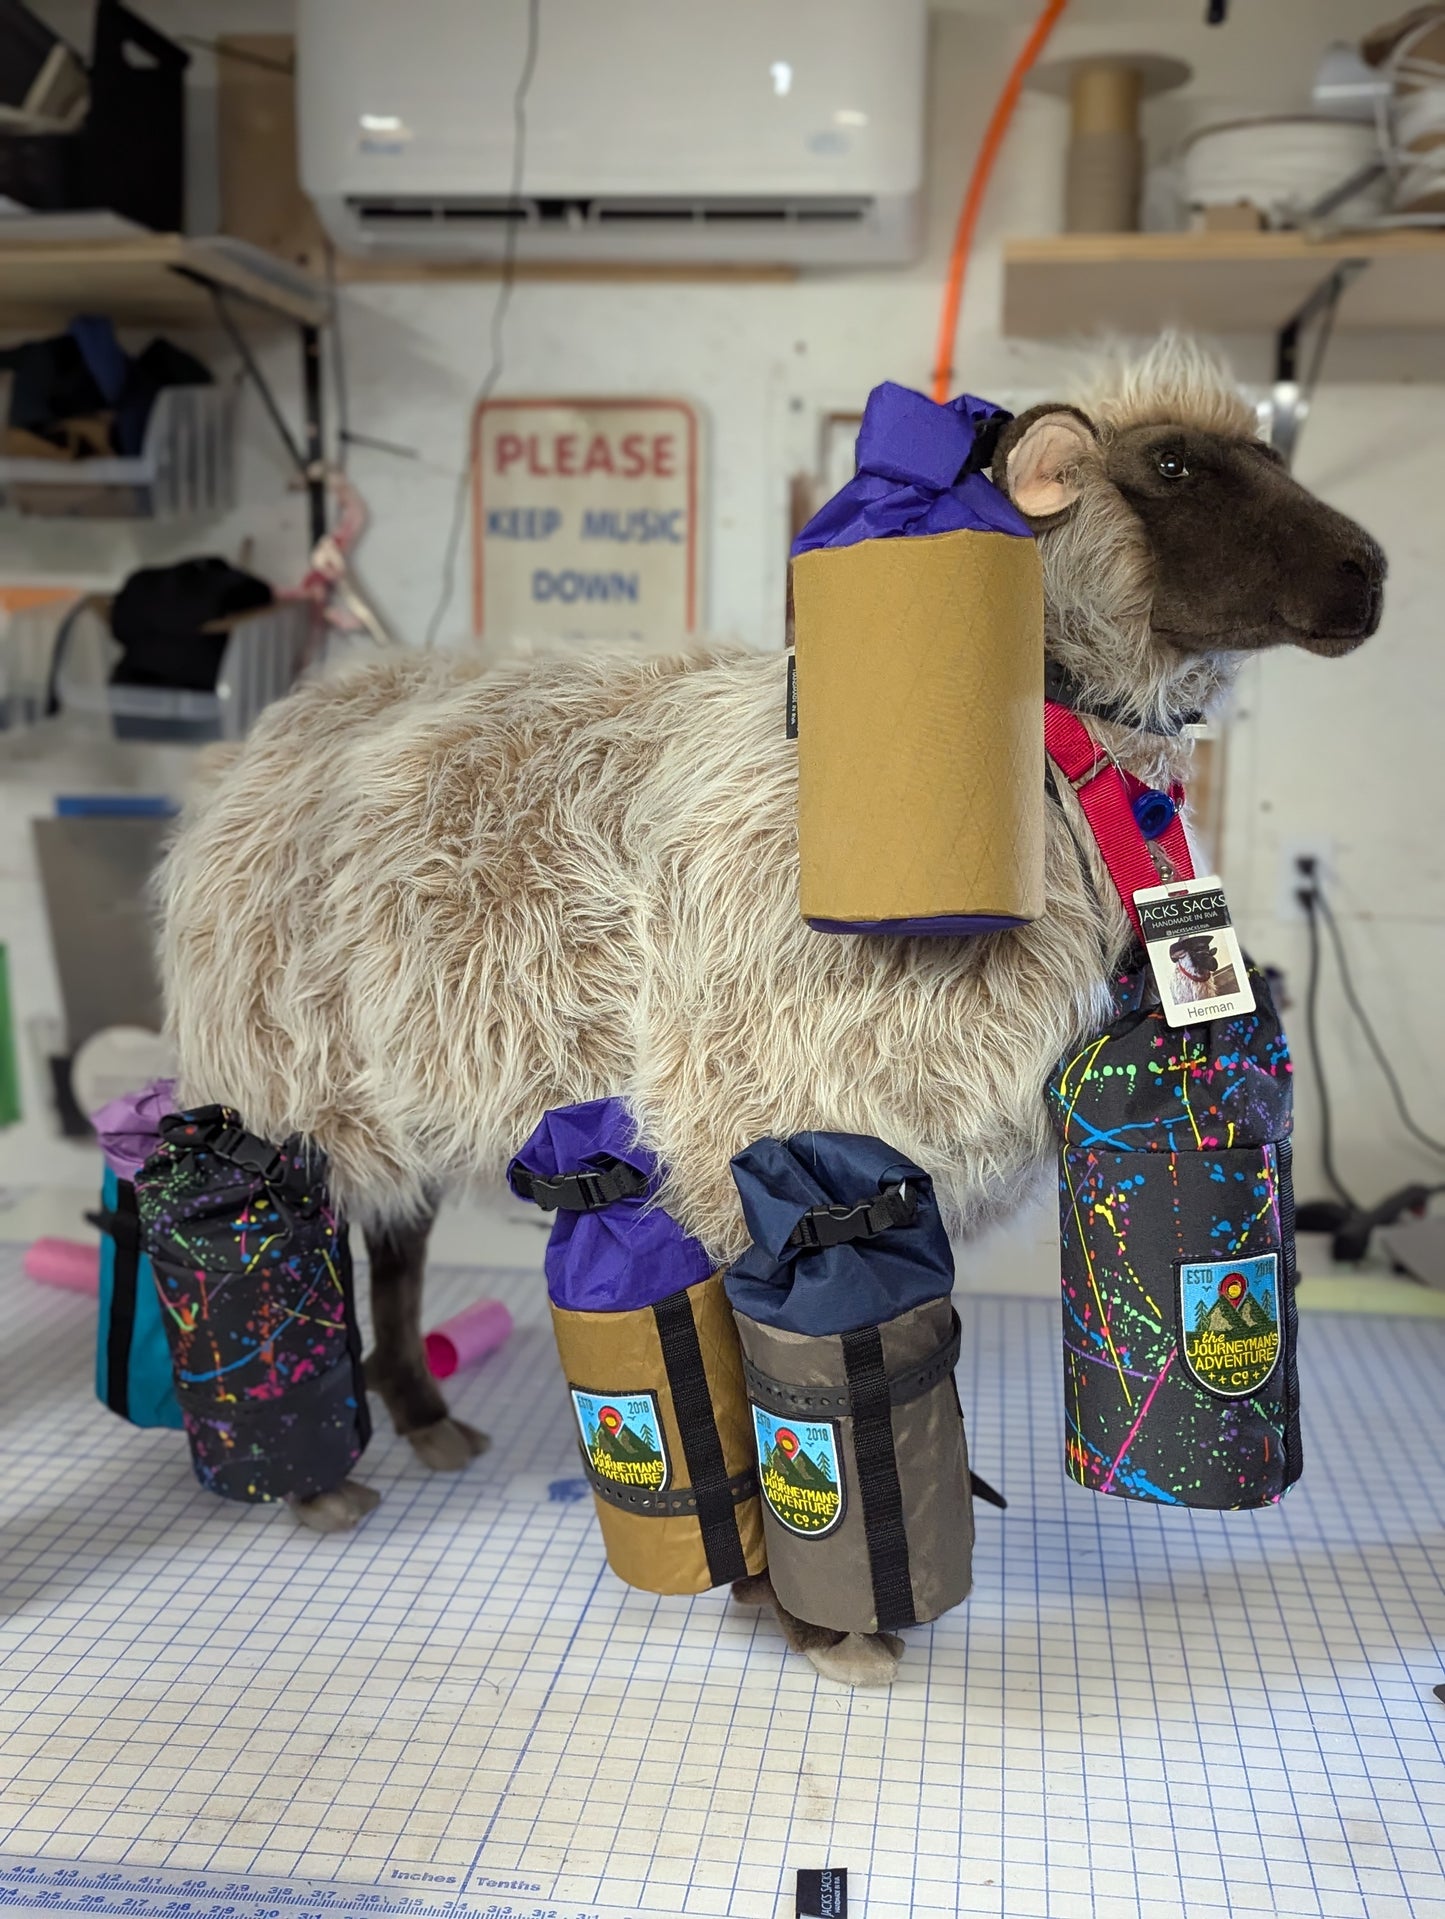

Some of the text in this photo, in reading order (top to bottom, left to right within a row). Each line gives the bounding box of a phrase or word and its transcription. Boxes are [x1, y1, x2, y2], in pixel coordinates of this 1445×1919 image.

[494, 432, 674, 478] PLEASE
[486, 508, 685, 544] KEEP MUSIC
[531, 569, 640, 604] DOWN
[1138, 894, 1227, 926] JACKS SACKS
[1151, 915, 1193, 929] HANDMADE
[1204, 910, 1218, 919] RVA
[1187, 1001, 1235, 1019] Herman
[1186, 1269, 1213, 1285] ESTD
[1186, 1332, 1278, 1357] JOURNEYMAN'S
[1202, 1331, 1225, 1344] the
[1194, 1347, 1276, 1371] ADVENTURE
[627, 1400, 650, 1415] 2018
[806, 1427, 829, 1441] 2018
[763, 1472, 840, 1505] JOURNEYMAN'S
[768, 1488, 835, 1516] ADVENTURE
[391, 1869, 541, 1892] Inches Tenths
[820, 1871, 835, 1918] JACKS SACKS
